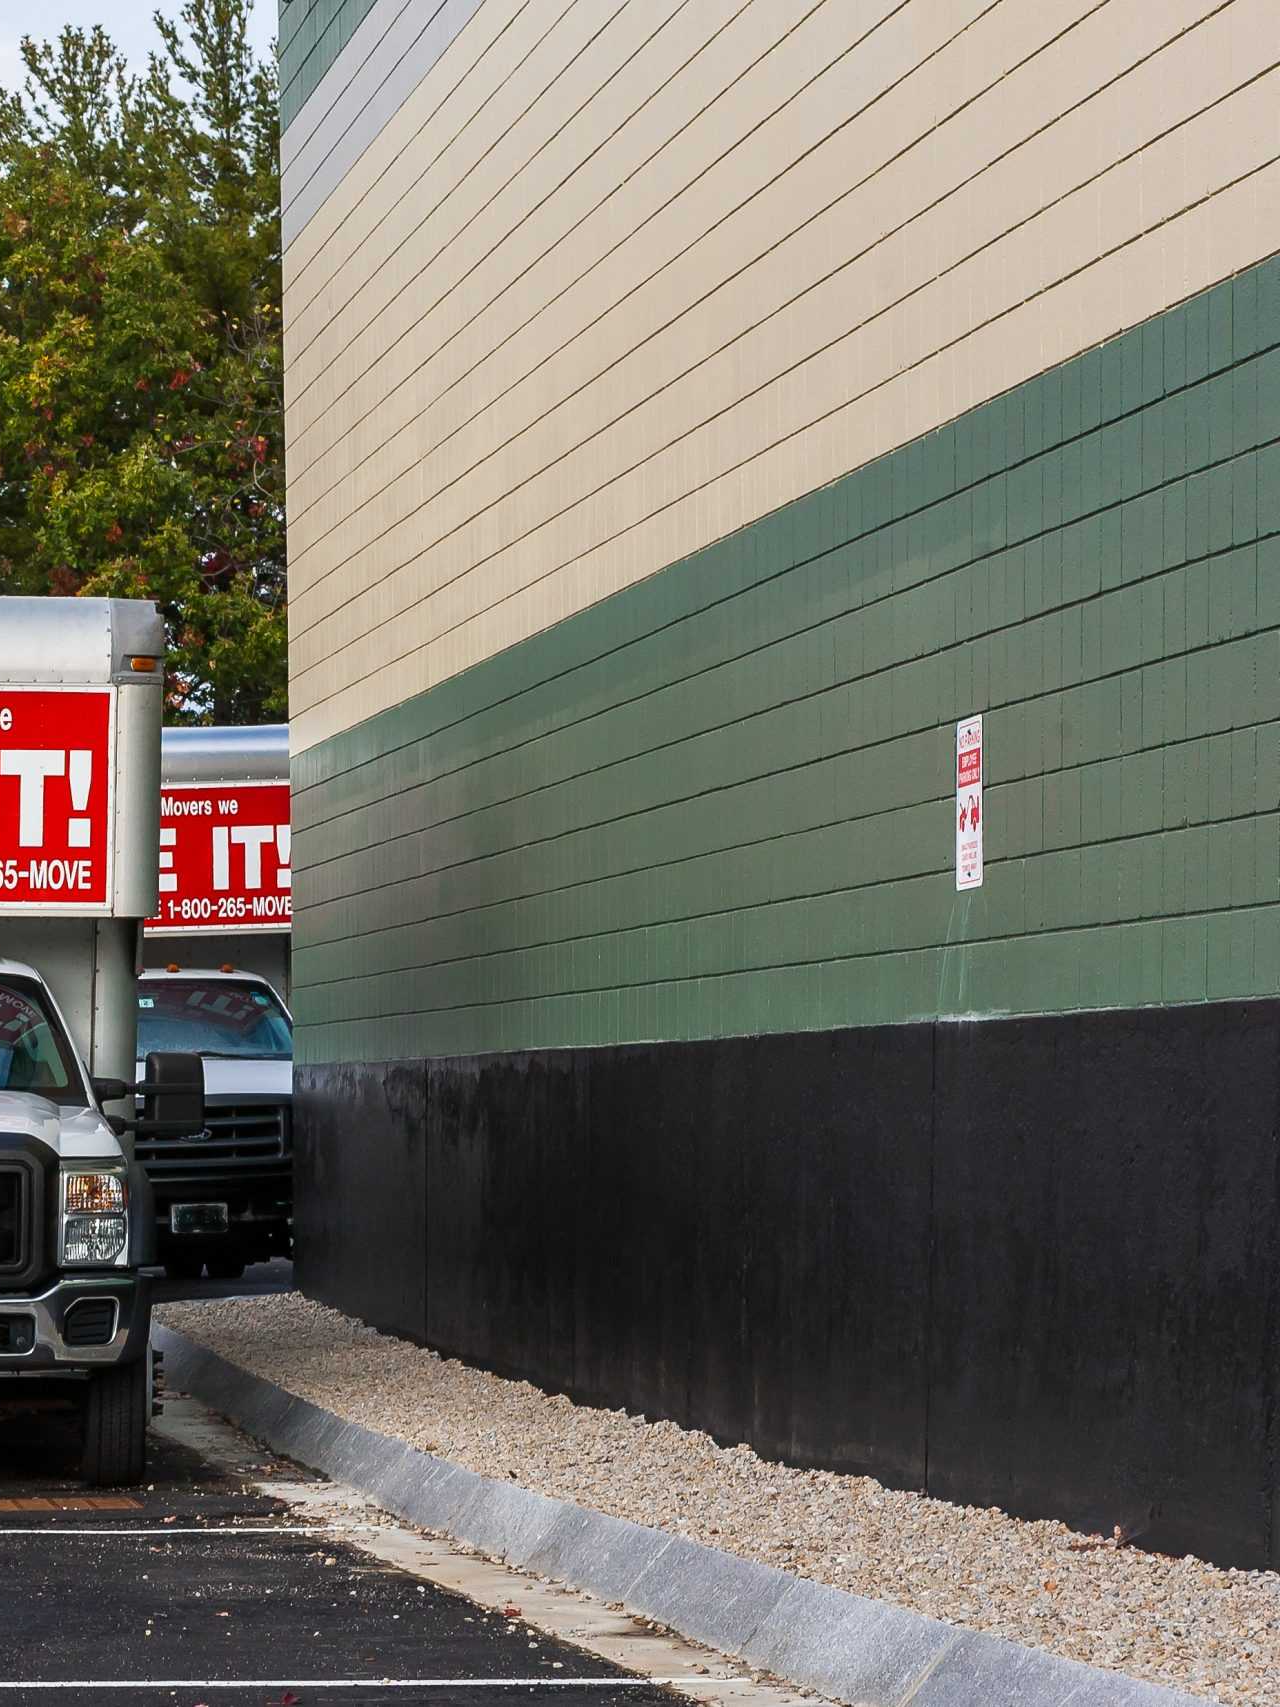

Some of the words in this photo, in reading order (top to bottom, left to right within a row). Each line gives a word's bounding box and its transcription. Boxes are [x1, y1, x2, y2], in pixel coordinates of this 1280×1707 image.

[160, 796, 213, 816] Movers
[217, 798, 239, 815] we
[212, 824, 291, 890] IT!
[167, 895, 293, 920] 1-800-265-MOVE
